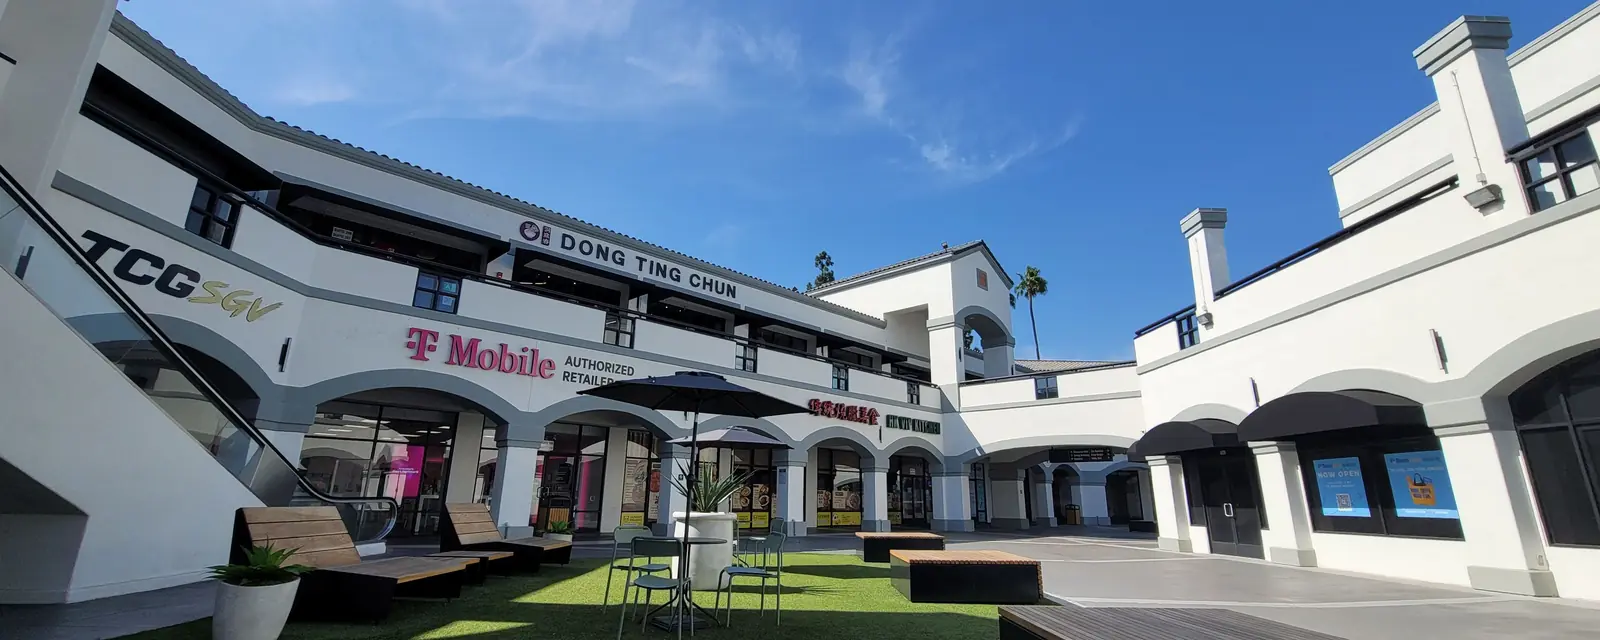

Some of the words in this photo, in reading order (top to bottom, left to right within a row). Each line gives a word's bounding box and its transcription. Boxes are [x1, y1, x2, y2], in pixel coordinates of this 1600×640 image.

[80, 229, 201, 298] TCG
[188, 280, 284, 323] SGV
[561, 233, 626, 267] DONG
[635, 255, 681, 283] TING
[689, 273, 737, 299] CHUN
[444, 334, 556, 380] Mobile
[564, 355, 635, 376] AUTHORIZED
[886, 414, 900, 429] HK
[1337, 470, 1360, 478] OPEN
